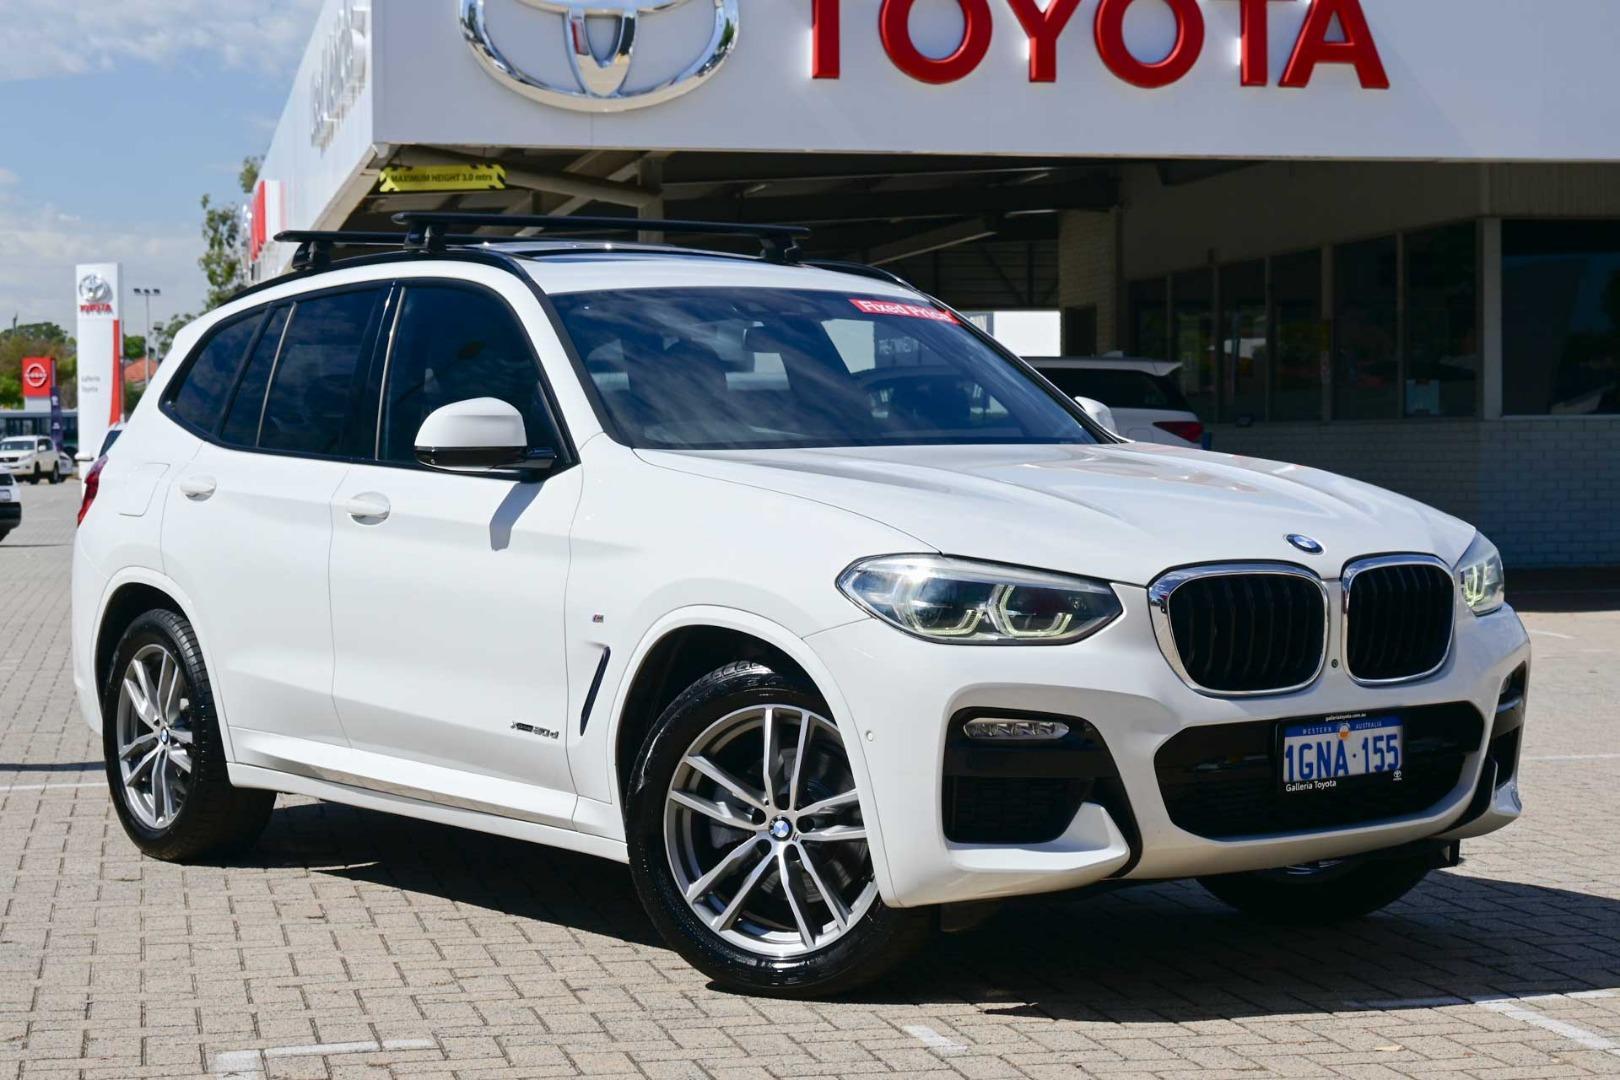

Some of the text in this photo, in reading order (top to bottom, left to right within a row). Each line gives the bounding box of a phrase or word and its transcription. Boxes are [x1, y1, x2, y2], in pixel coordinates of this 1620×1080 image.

[390, 174, 430, 183] MAXIMUM
[431, 174, 460, 183] HEIGHT
[462, 173, 474, 182] 3.0
[857, 299, 907, 315] Fixed
[1302, 721, 1382, 735] WESTERN AUSTRALIA
[1285, 780, 1337, 792] Galleria Toyota
